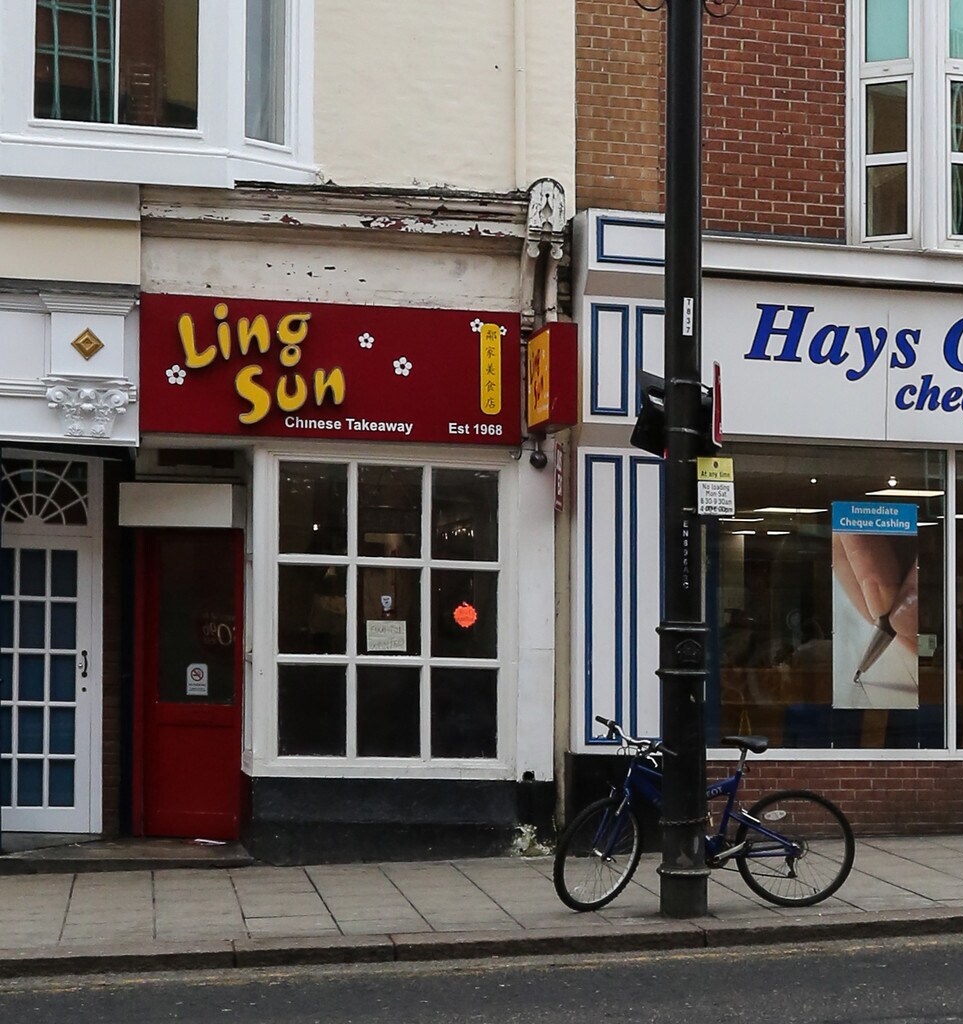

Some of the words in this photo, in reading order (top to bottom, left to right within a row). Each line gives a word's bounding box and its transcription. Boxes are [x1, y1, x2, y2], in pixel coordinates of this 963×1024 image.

[178, 302, 312, 369] Ling
[744, 303, 922, 381] Hays
[235, 364, 346, 425] Sun
[284, 416, 342, 431] Chinese
[345, 418, 413, 435] Takeaway
[448, 422, 470, 435] Est
[473, 423, 503, 436] 1968
[851, 505, 899, 516] Immediate
[839, 517, 874, 529] Cheque
[875, 519, 911, 530] Cashing
